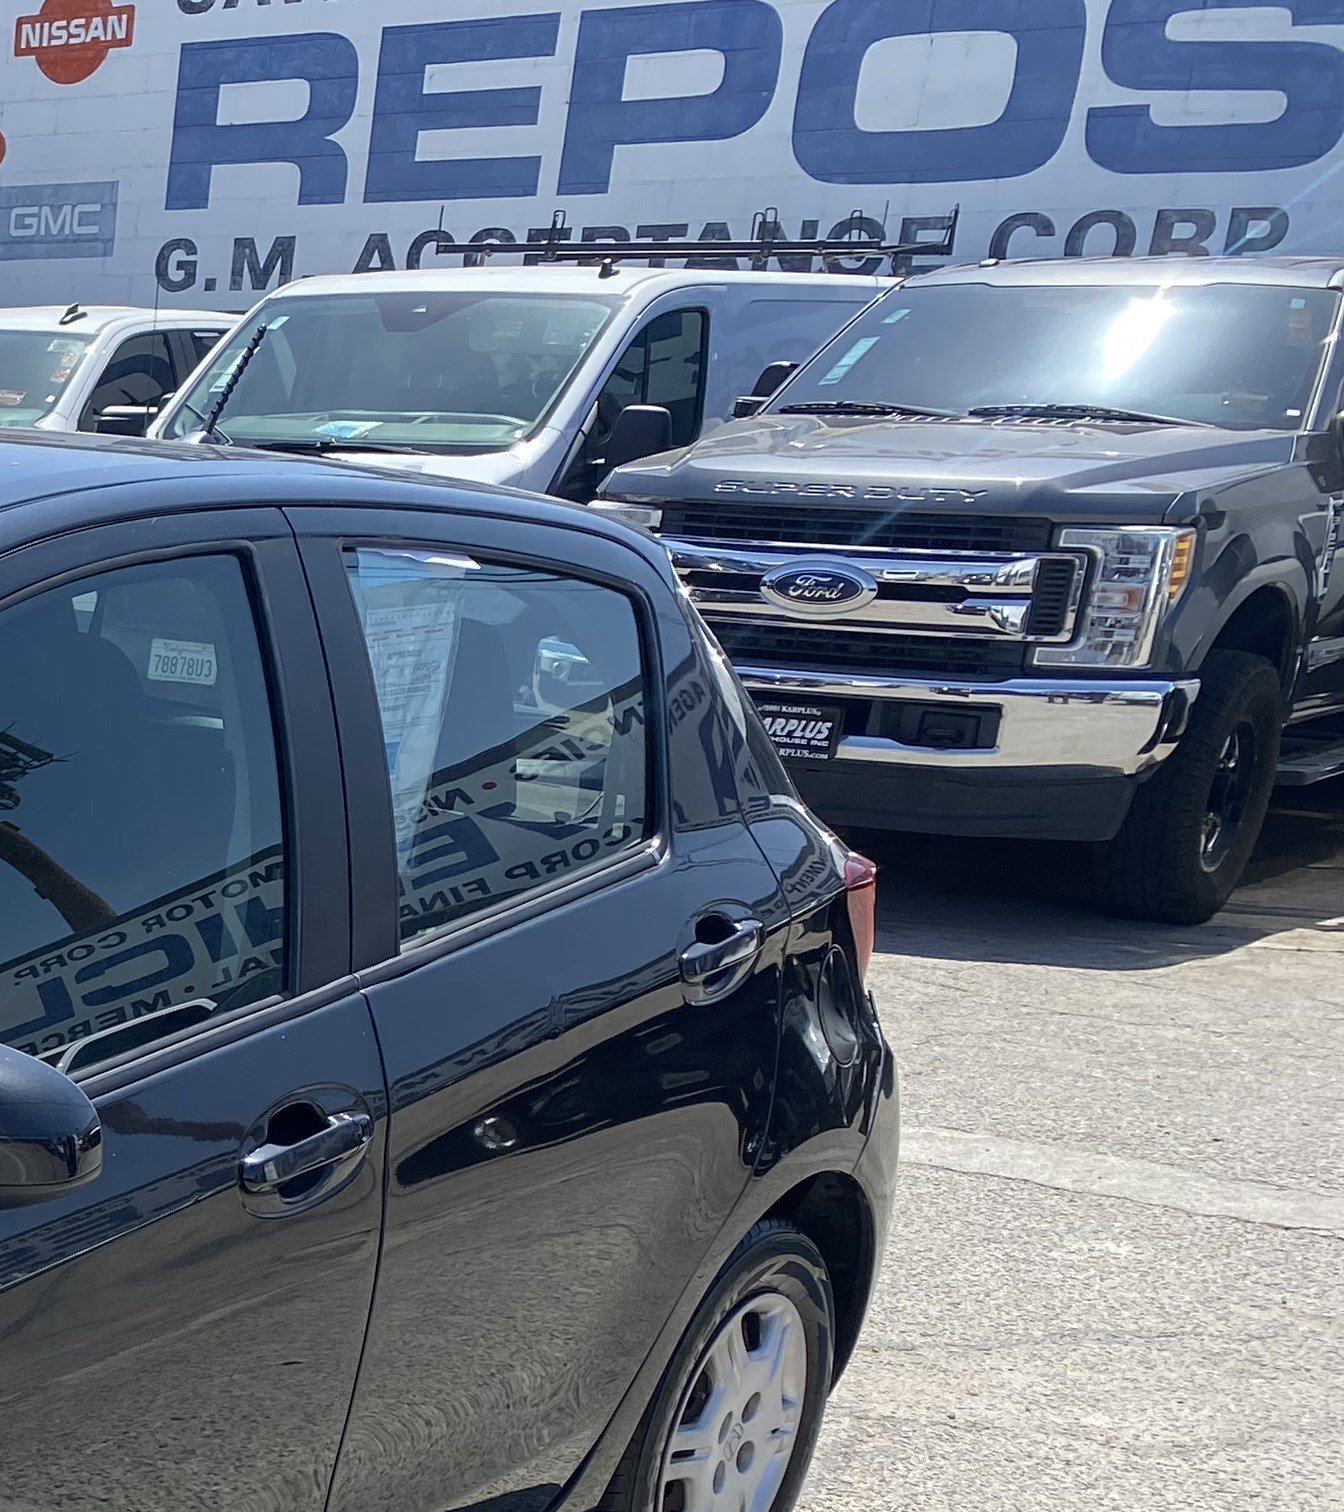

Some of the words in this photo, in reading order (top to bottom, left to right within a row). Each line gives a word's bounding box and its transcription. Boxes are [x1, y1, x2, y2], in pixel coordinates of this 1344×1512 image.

[20, 12, 128, 50] NISSAN
[164, 0, 1344, 211] REPOS
[9, 203, 102, 238] GMC
[155, 235, 315, 293] G.M.
[714, 479, 857, 498] SUPER
[864, 486, 989, 503] DUTY
[788, 574, 845, 600] Ford
[154, 654, 213, 678] 78878U3
